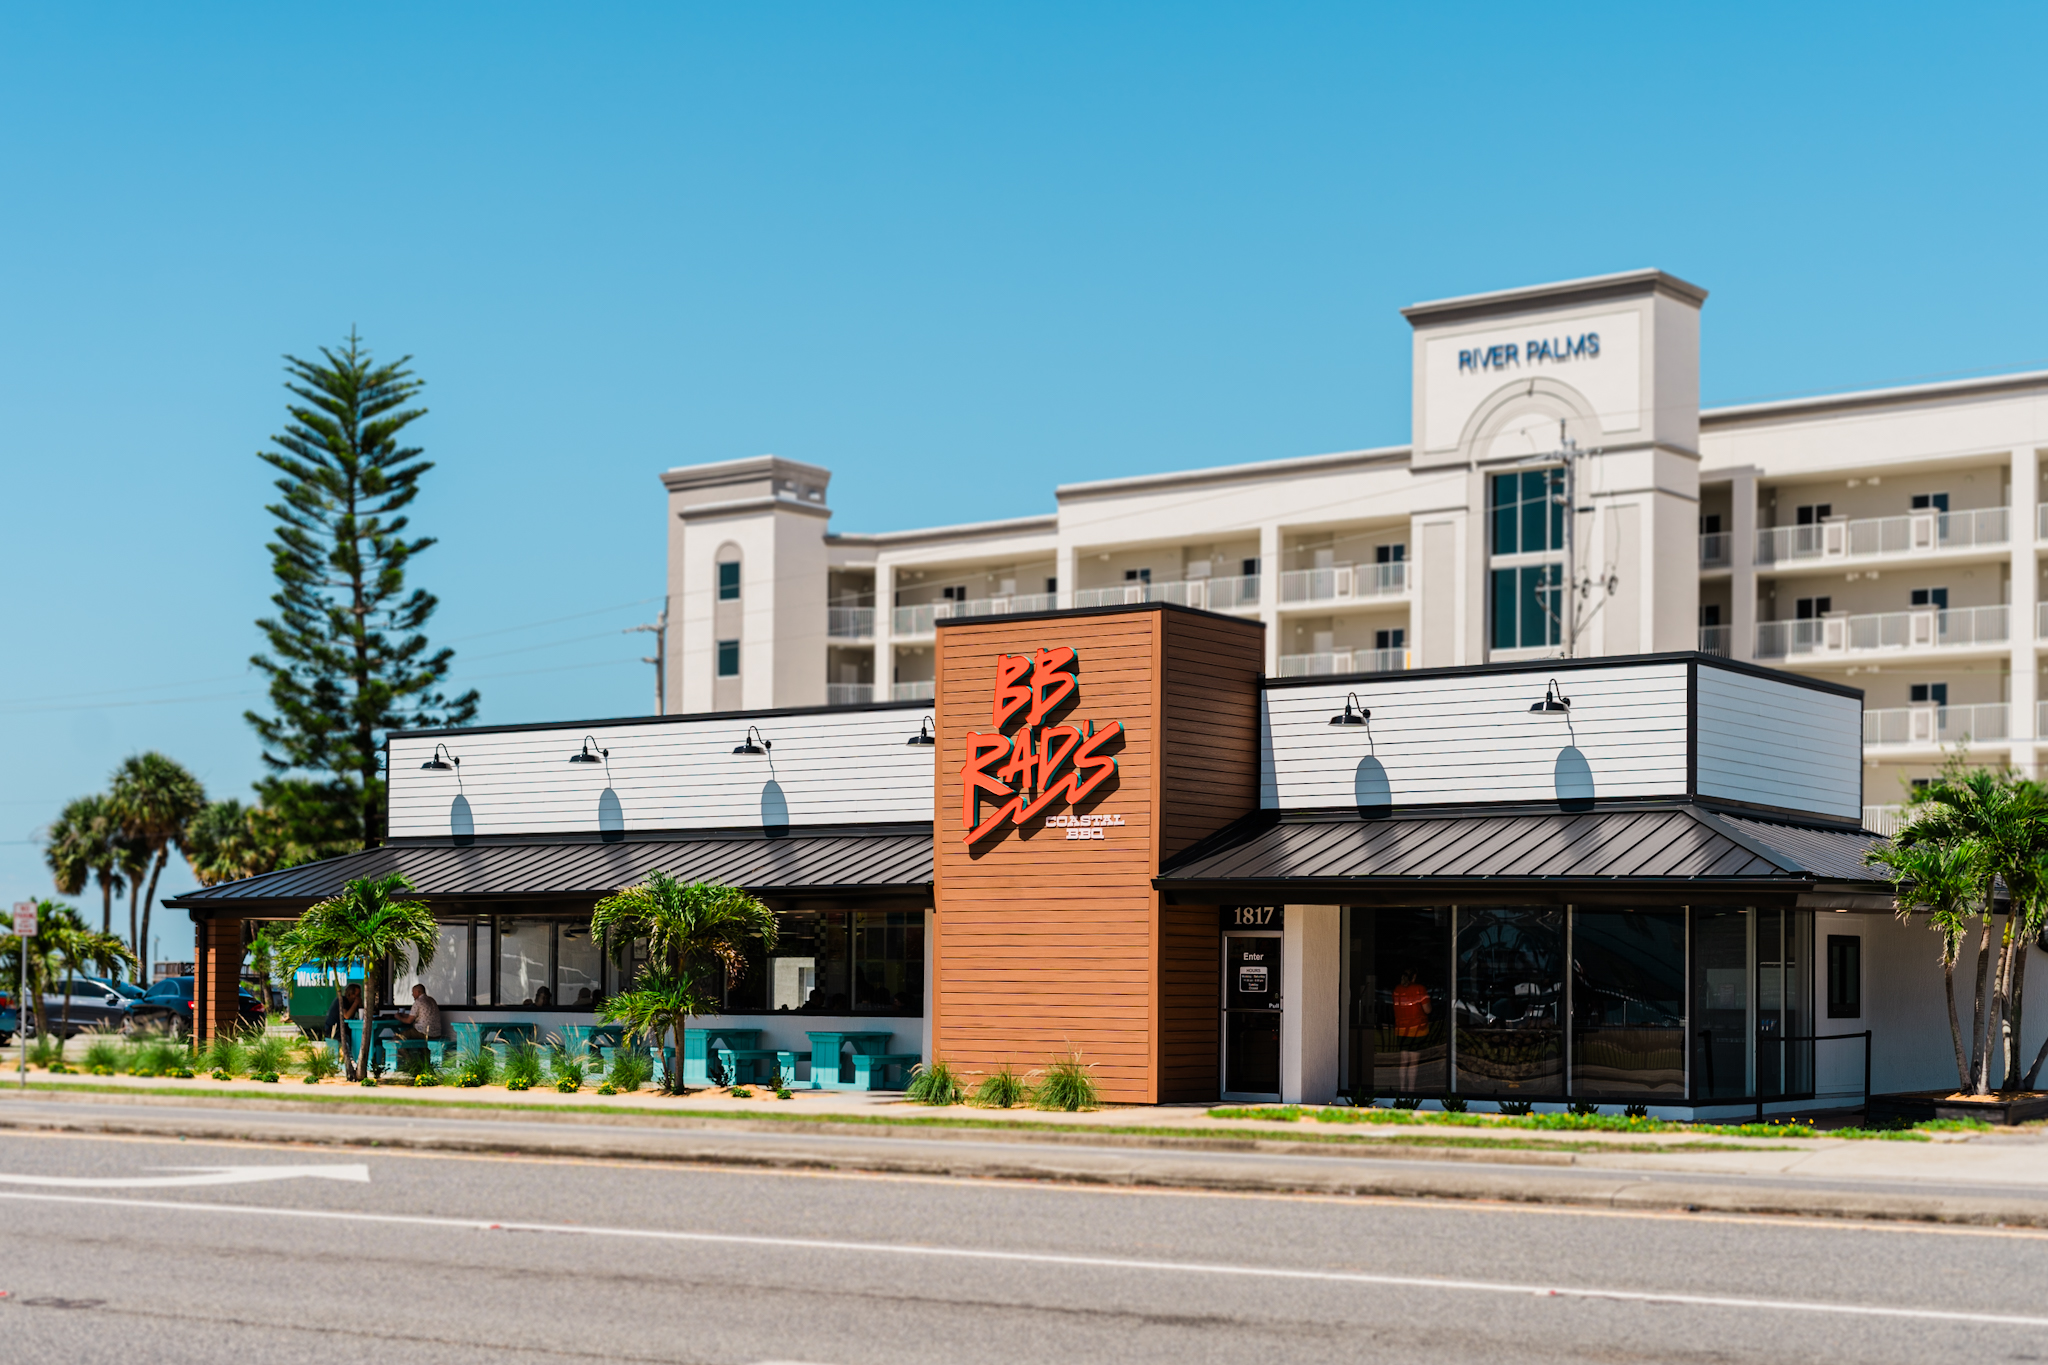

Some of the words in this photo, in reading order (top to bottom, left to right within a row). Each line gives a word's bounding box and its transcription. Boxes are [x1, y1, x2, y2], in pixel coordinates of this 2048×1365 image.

[1458, 343, 1519, 371] RIVER
[1526, 332, 1600, 361] PALMS
[992, 646, 1079, 729] BB
[960, 719, 1124, 846] RAD'S
[1045, 814, 1125, 828] COASTAL
[1066, 828, 1105, 840] BBQ
[1234, 906, 1274, 925] 1817
[1243, 952, 1264, 961] Enter
